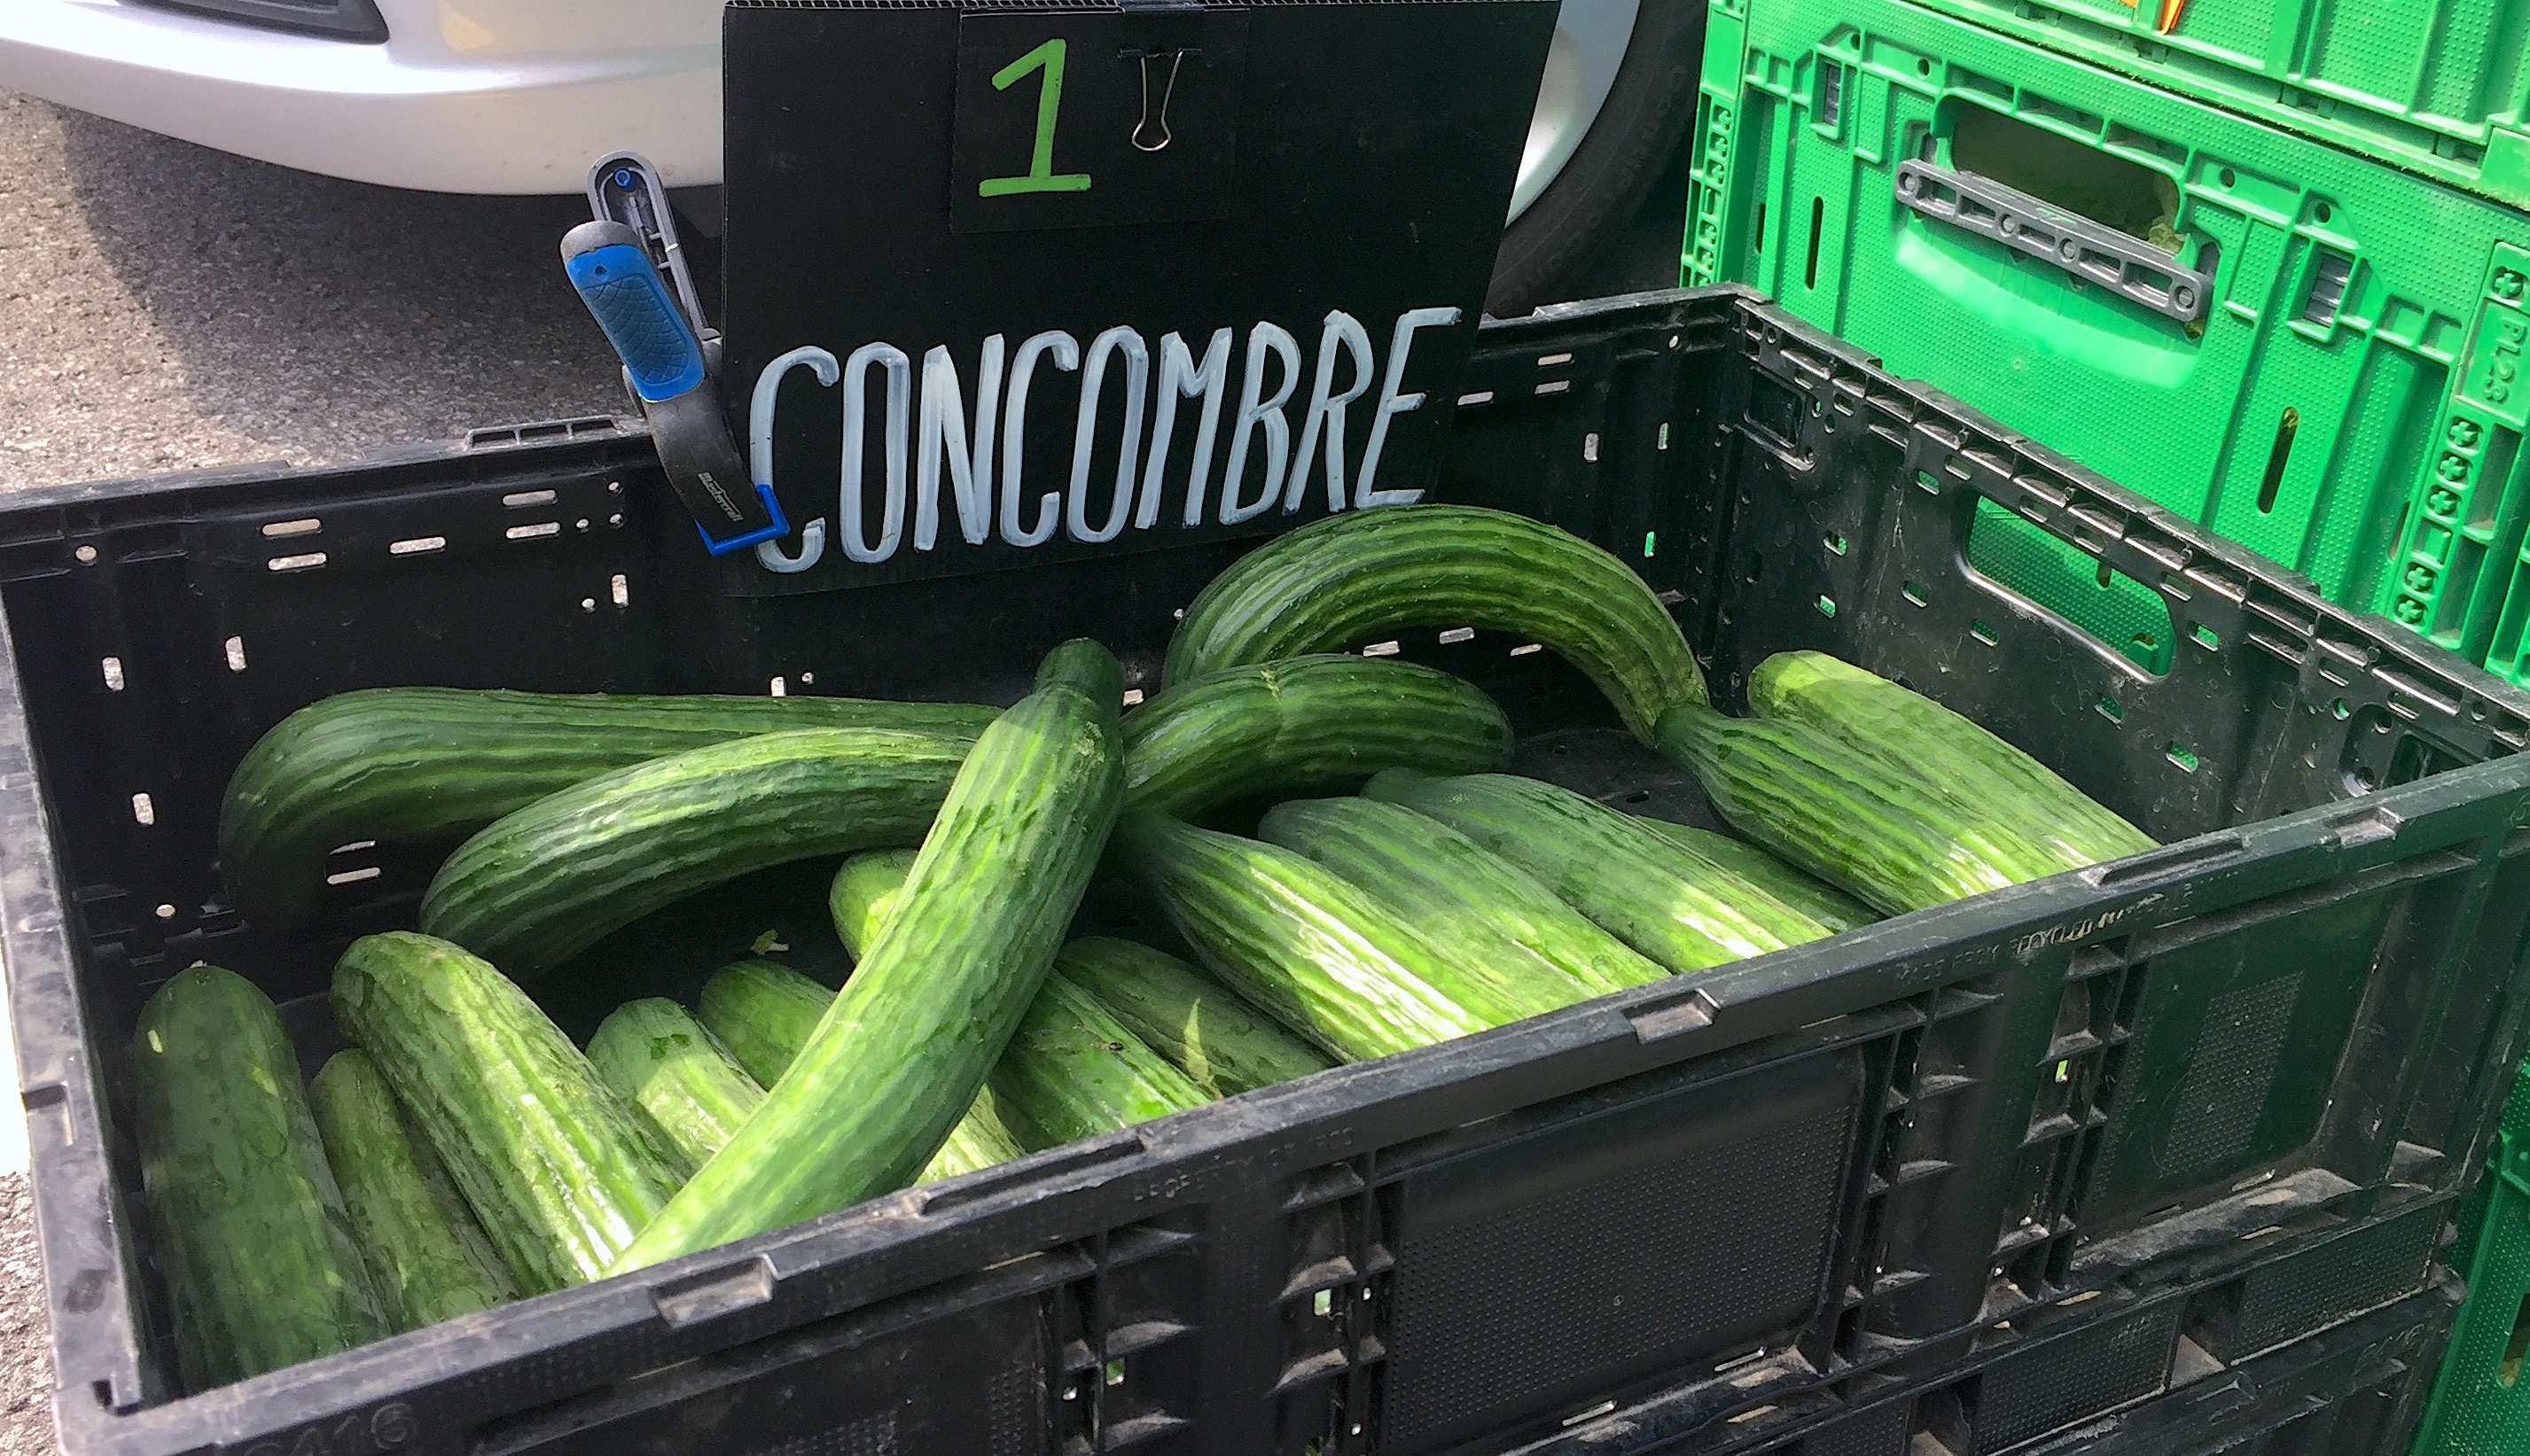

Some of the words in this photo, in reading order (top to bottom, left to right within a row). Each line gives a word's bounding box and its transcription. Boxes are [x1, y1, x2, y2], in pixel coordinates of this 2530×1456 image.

[979, 38, 1091, 197] 1
[2484, 316, 2527, 405] PL23
[749, 307, 1463, 574] CONCOMBRE
